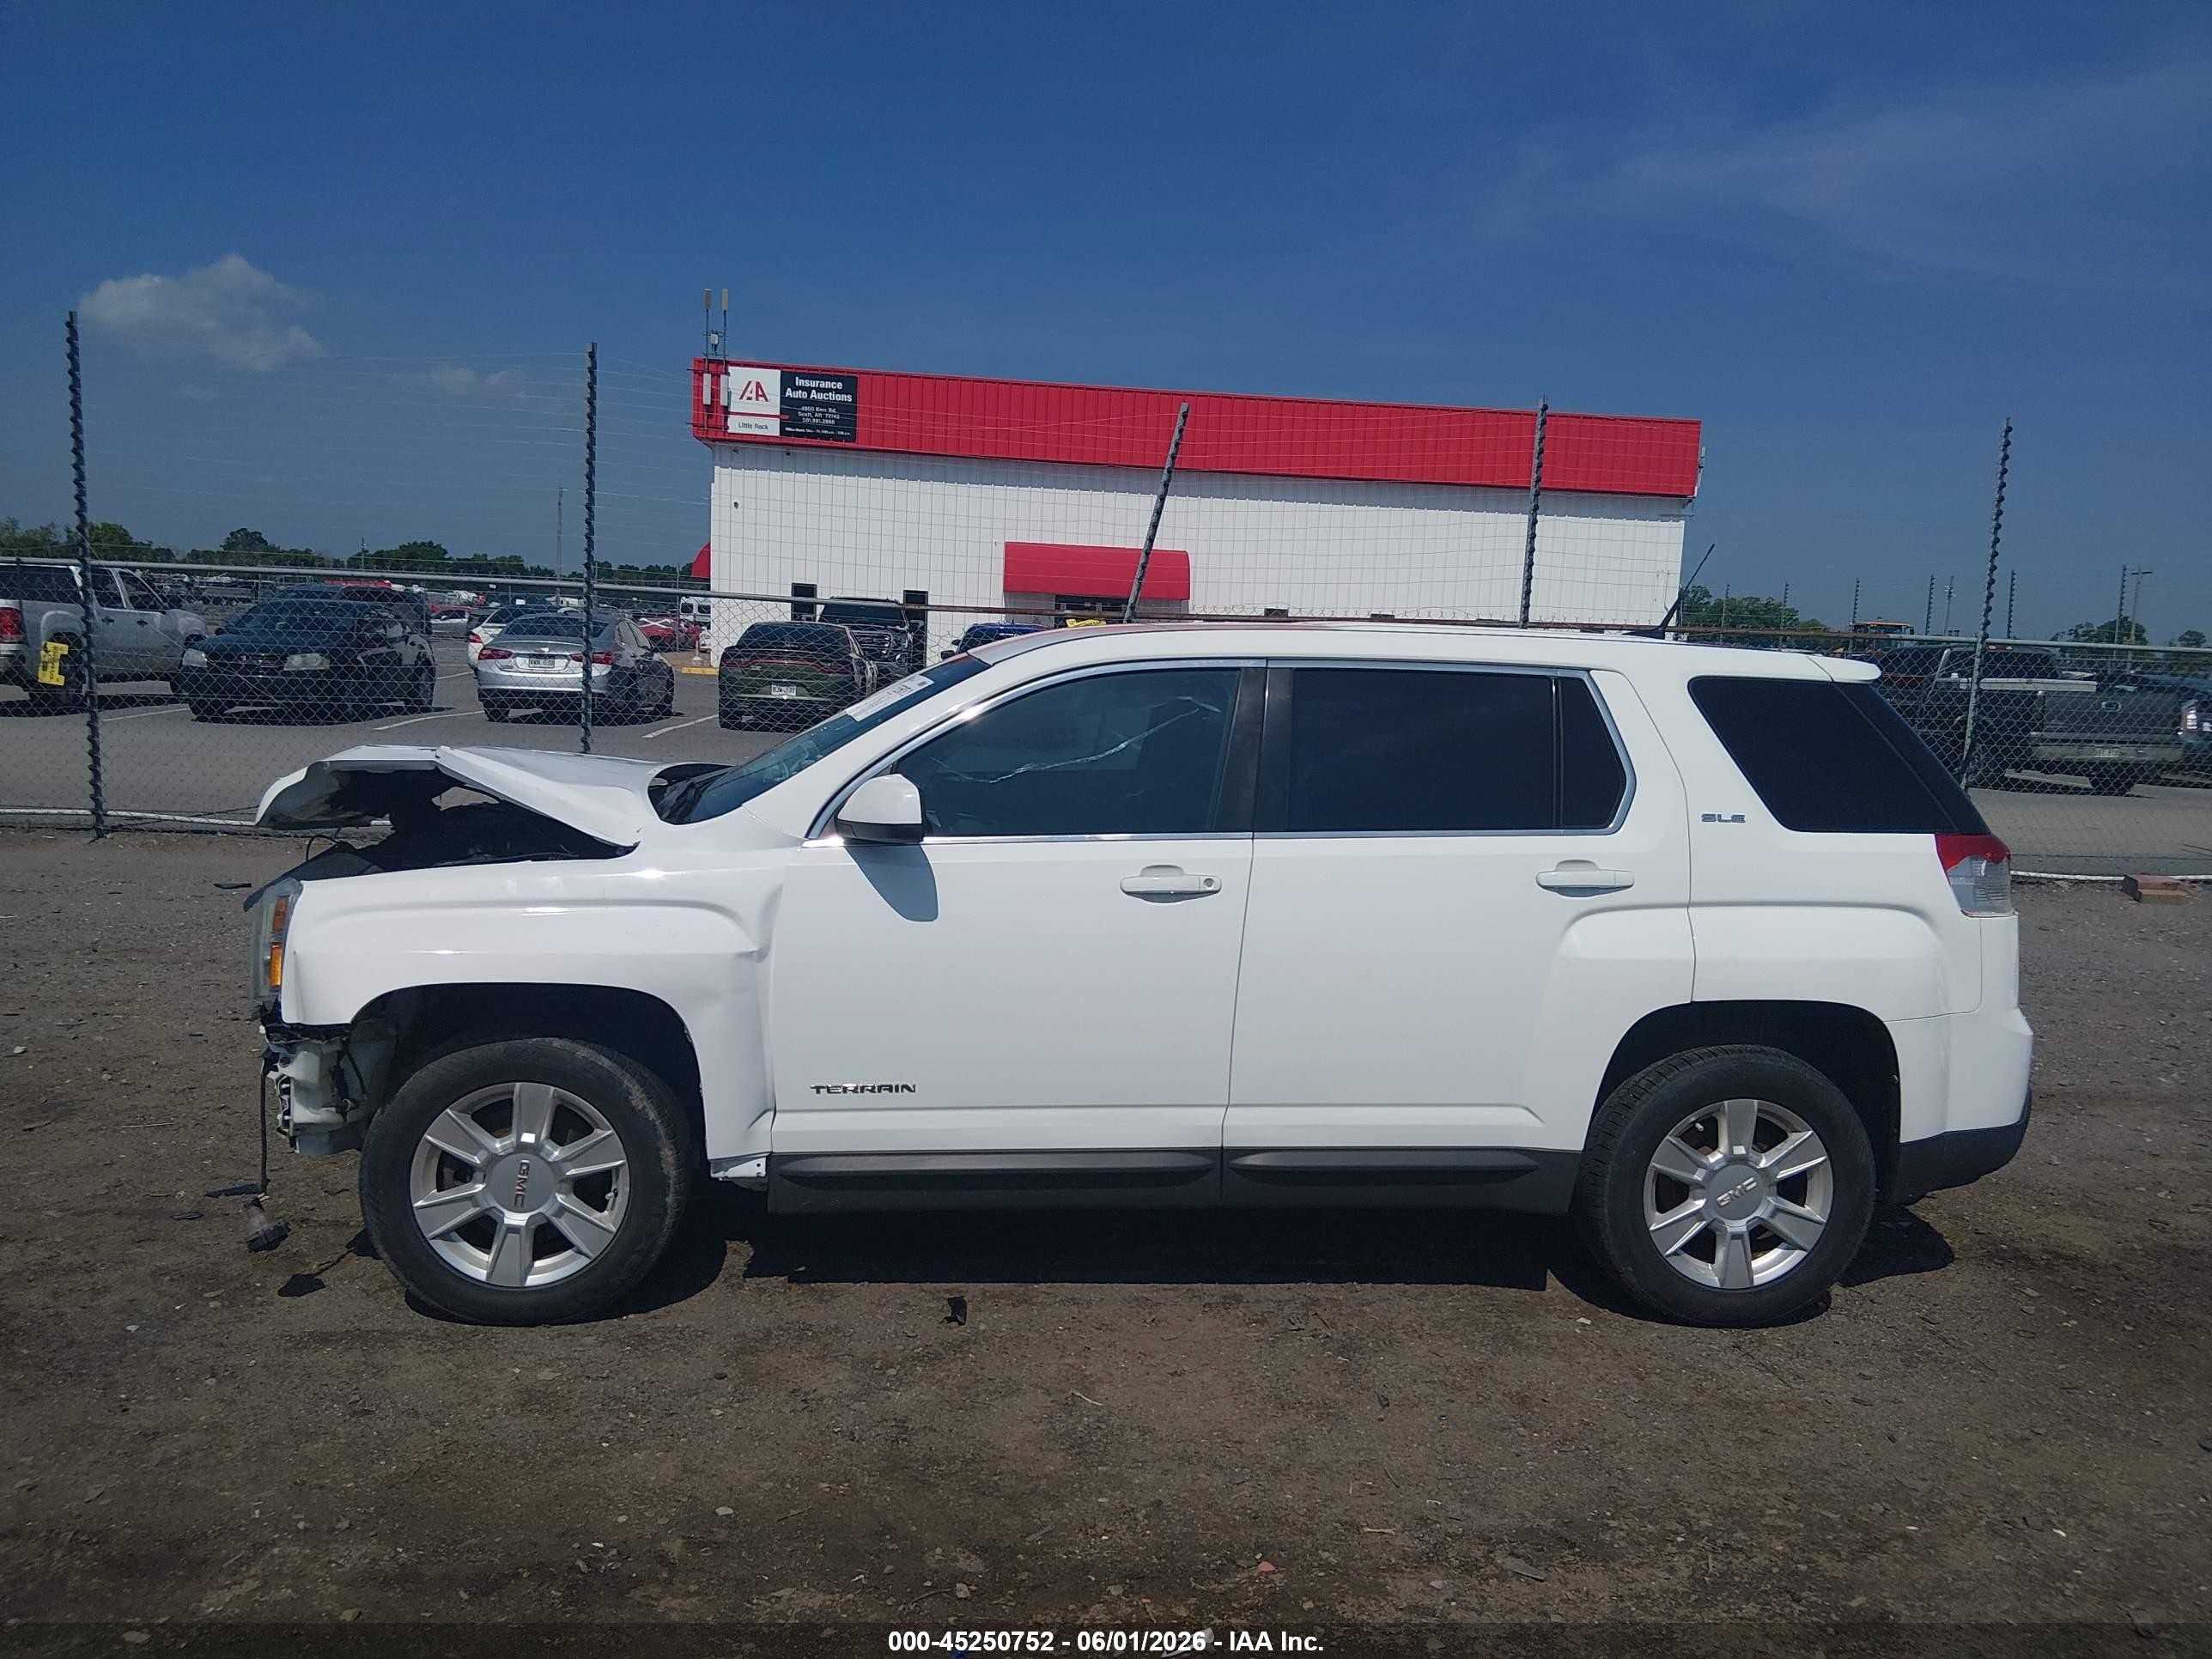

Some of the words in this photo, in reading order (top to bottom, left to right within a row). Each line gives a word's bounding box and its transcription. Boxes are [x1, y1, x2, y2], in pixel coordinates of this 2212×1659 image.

[795, 376, 843, 389] Insurance
[785, 387, 808, 398] Auto
[810, 389, 853, 402] Auctions
[1701, 812, 1746, 823] SLE
[810, 1083, 916, 1094] TERRAIN
[514, 1159, 529, 1208] GMC
[1717, 1177, 1757, 1207] GMC
